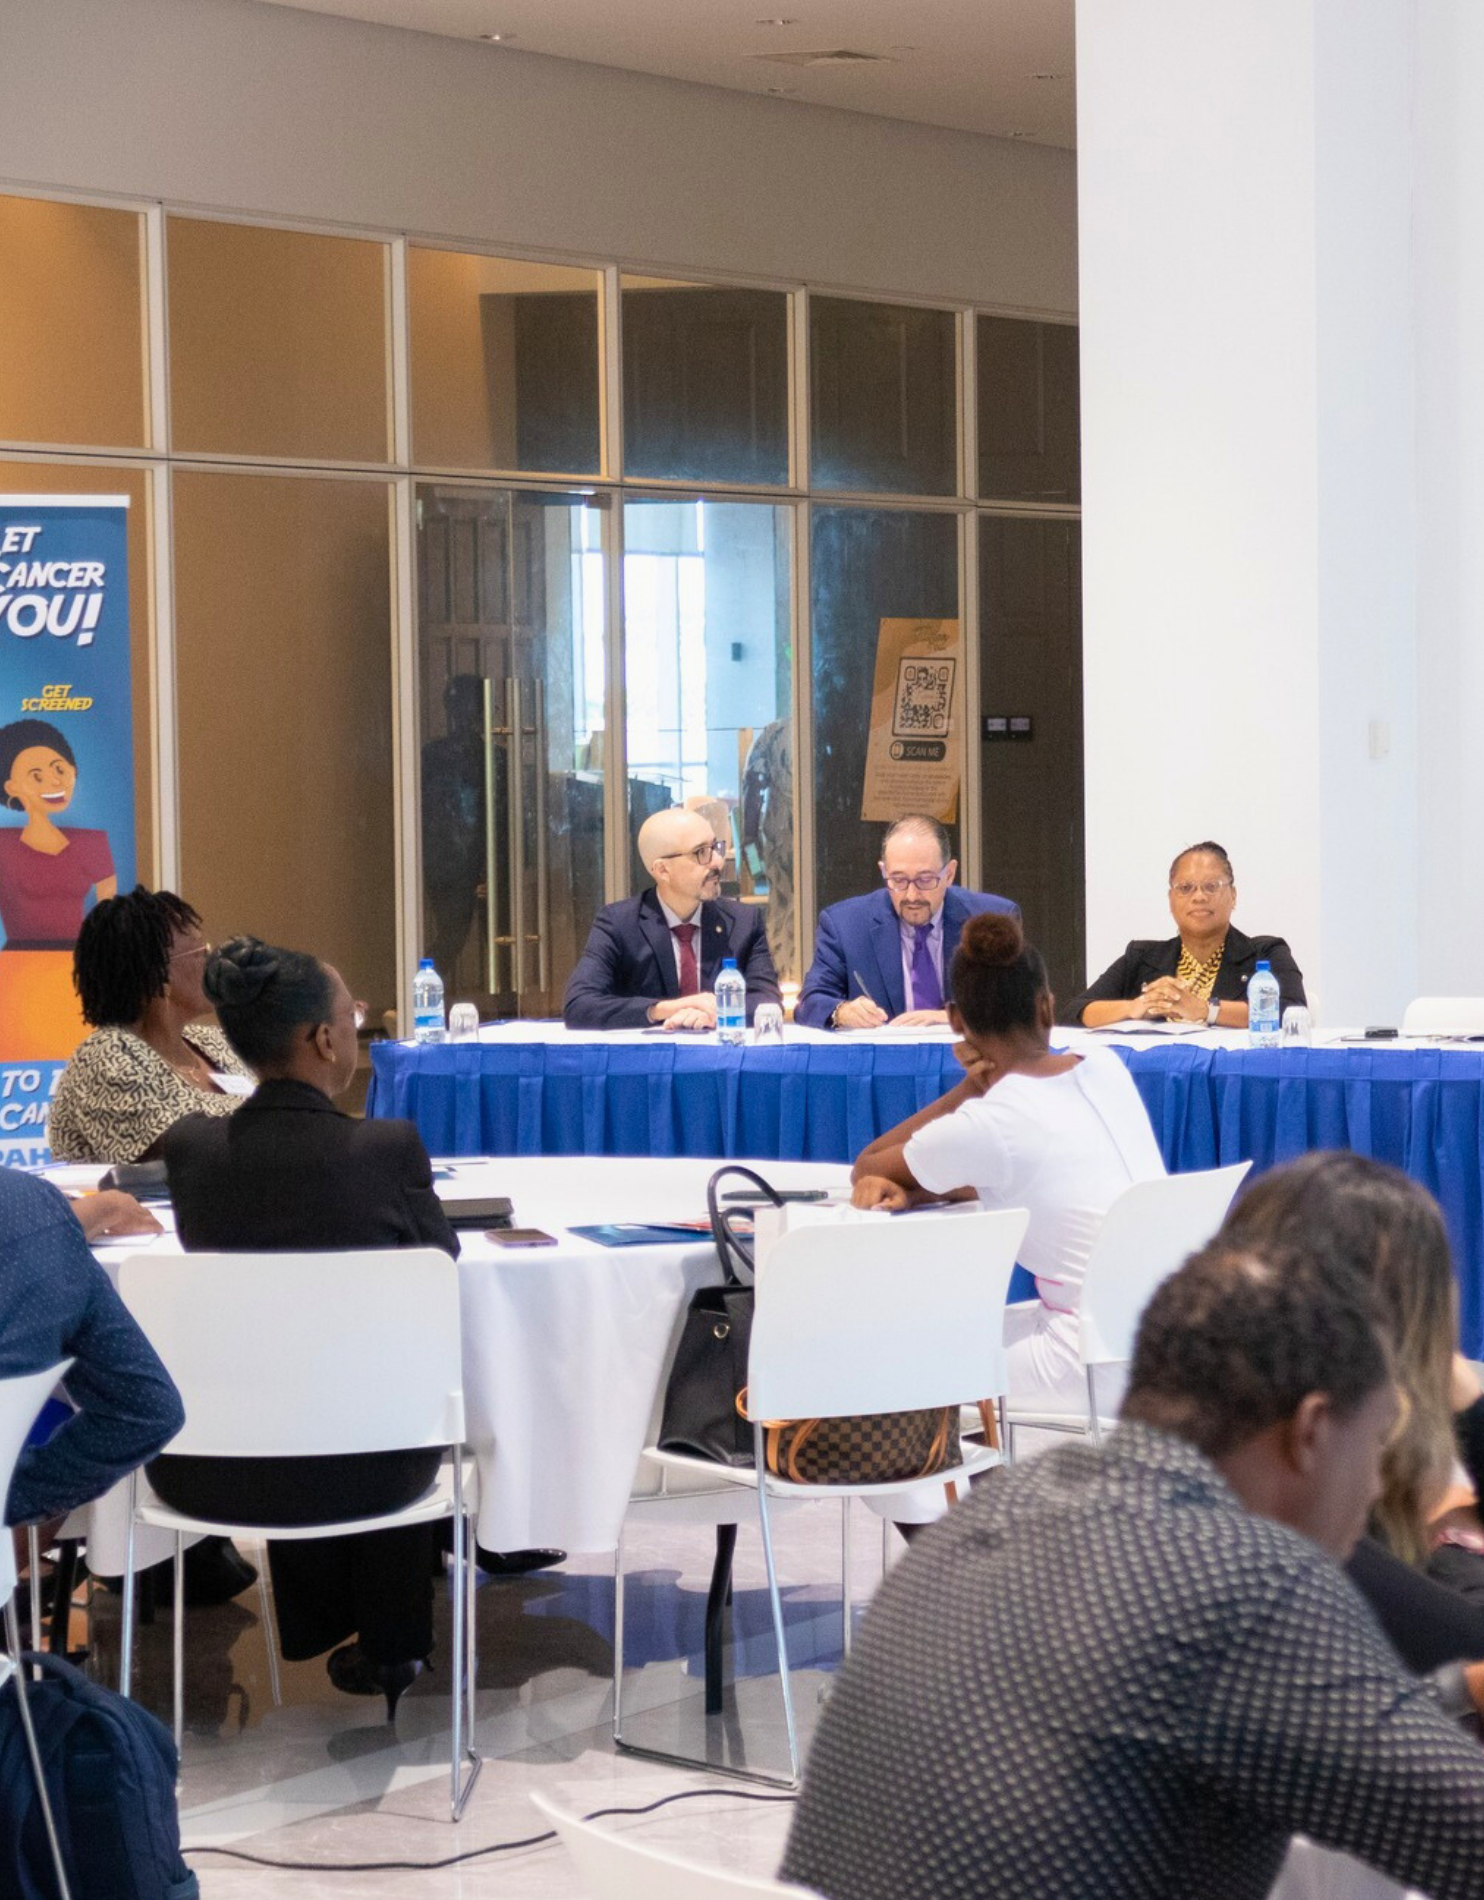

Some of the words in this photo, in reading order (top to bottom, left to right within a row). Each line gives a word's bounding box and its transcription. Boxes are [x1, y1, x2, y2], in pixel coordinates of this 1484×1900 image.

[0, 526, 42, 555] ET
[42, 684, 73, 698] GET
[21, 697, 93, 711] SCREENED
[906, 746, 927, 757] SCAN
[929, 747, 940, 758] ME
[2, 1069, 40, 1099] TO
